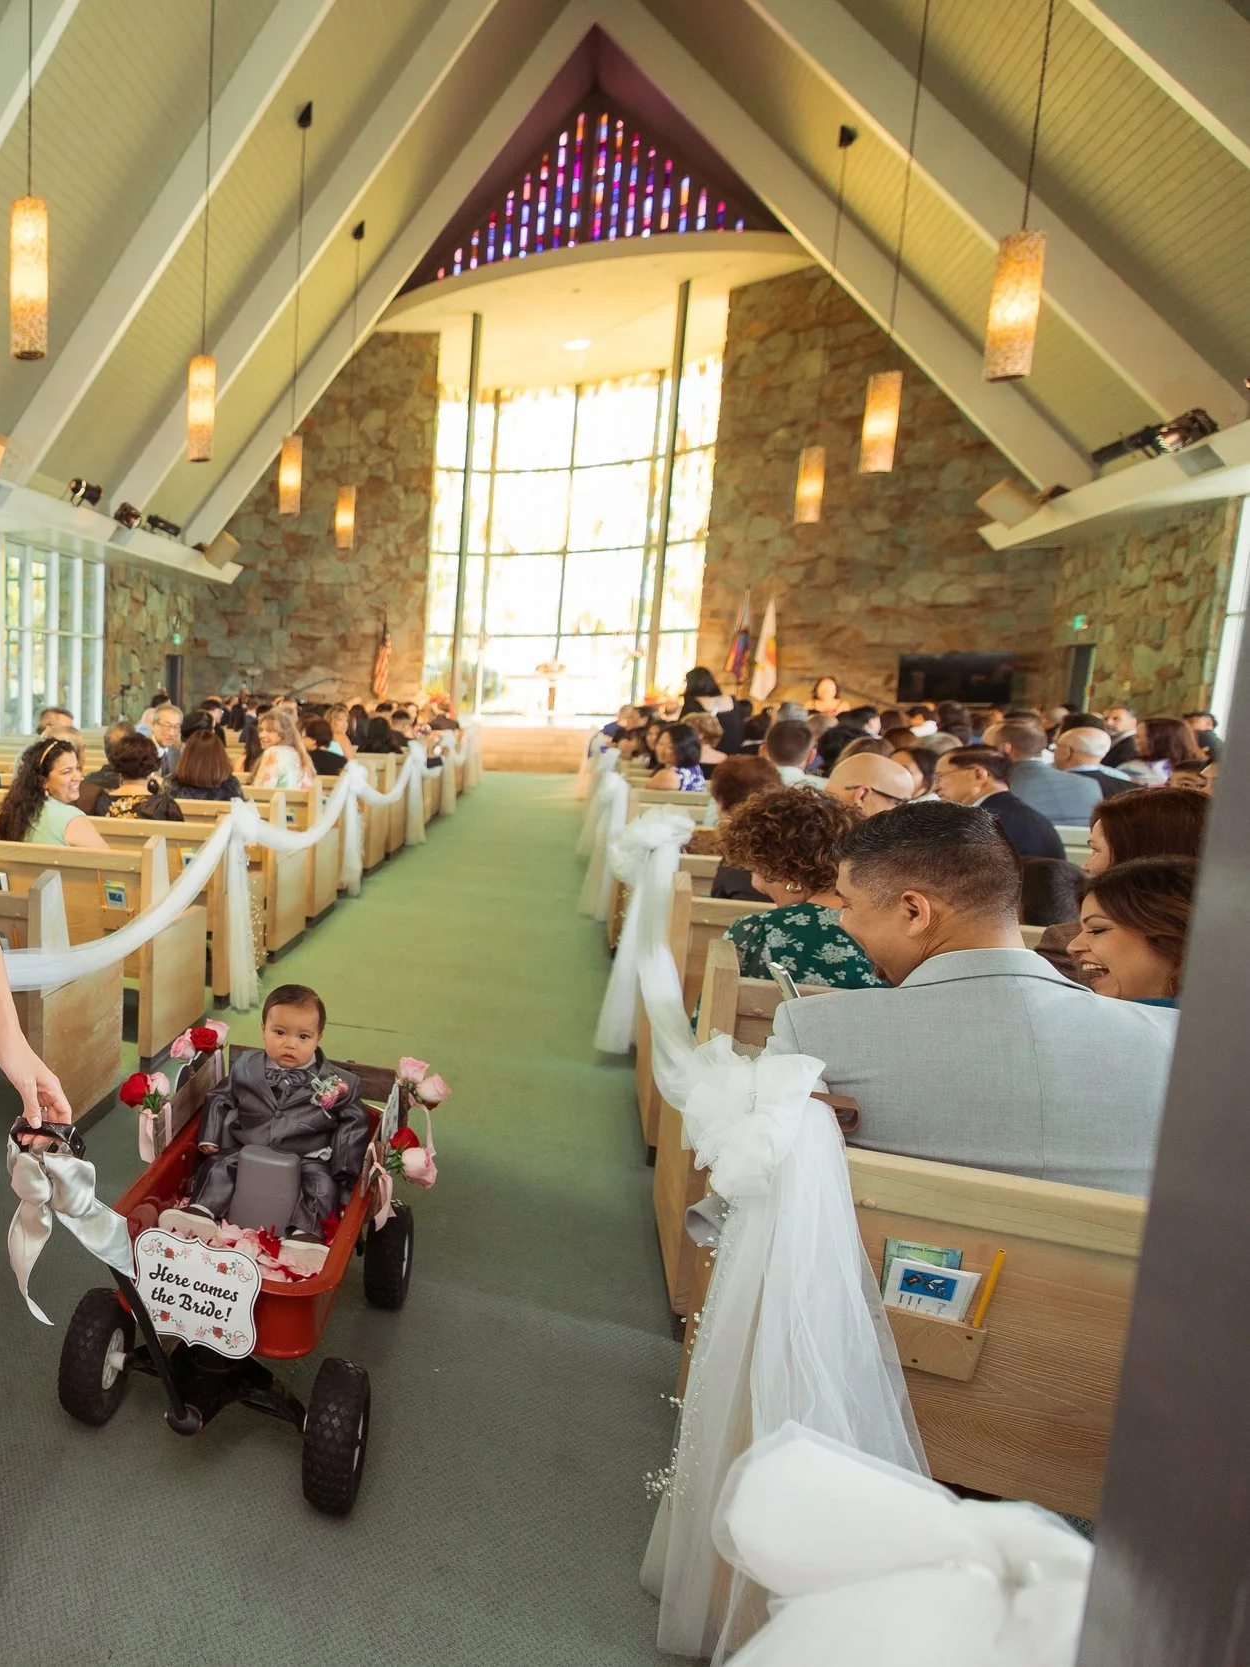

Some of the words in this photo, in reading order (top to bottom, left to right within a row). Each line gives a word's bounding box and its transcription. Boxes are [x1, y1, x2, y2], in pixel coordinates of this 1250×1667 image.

[149, 1263, 191, 1287] Here
[193, 1281, 239, 1302] comes
[151, 1286, 176, 1306] the
[179, 1293, 232, 1322] Bride!
